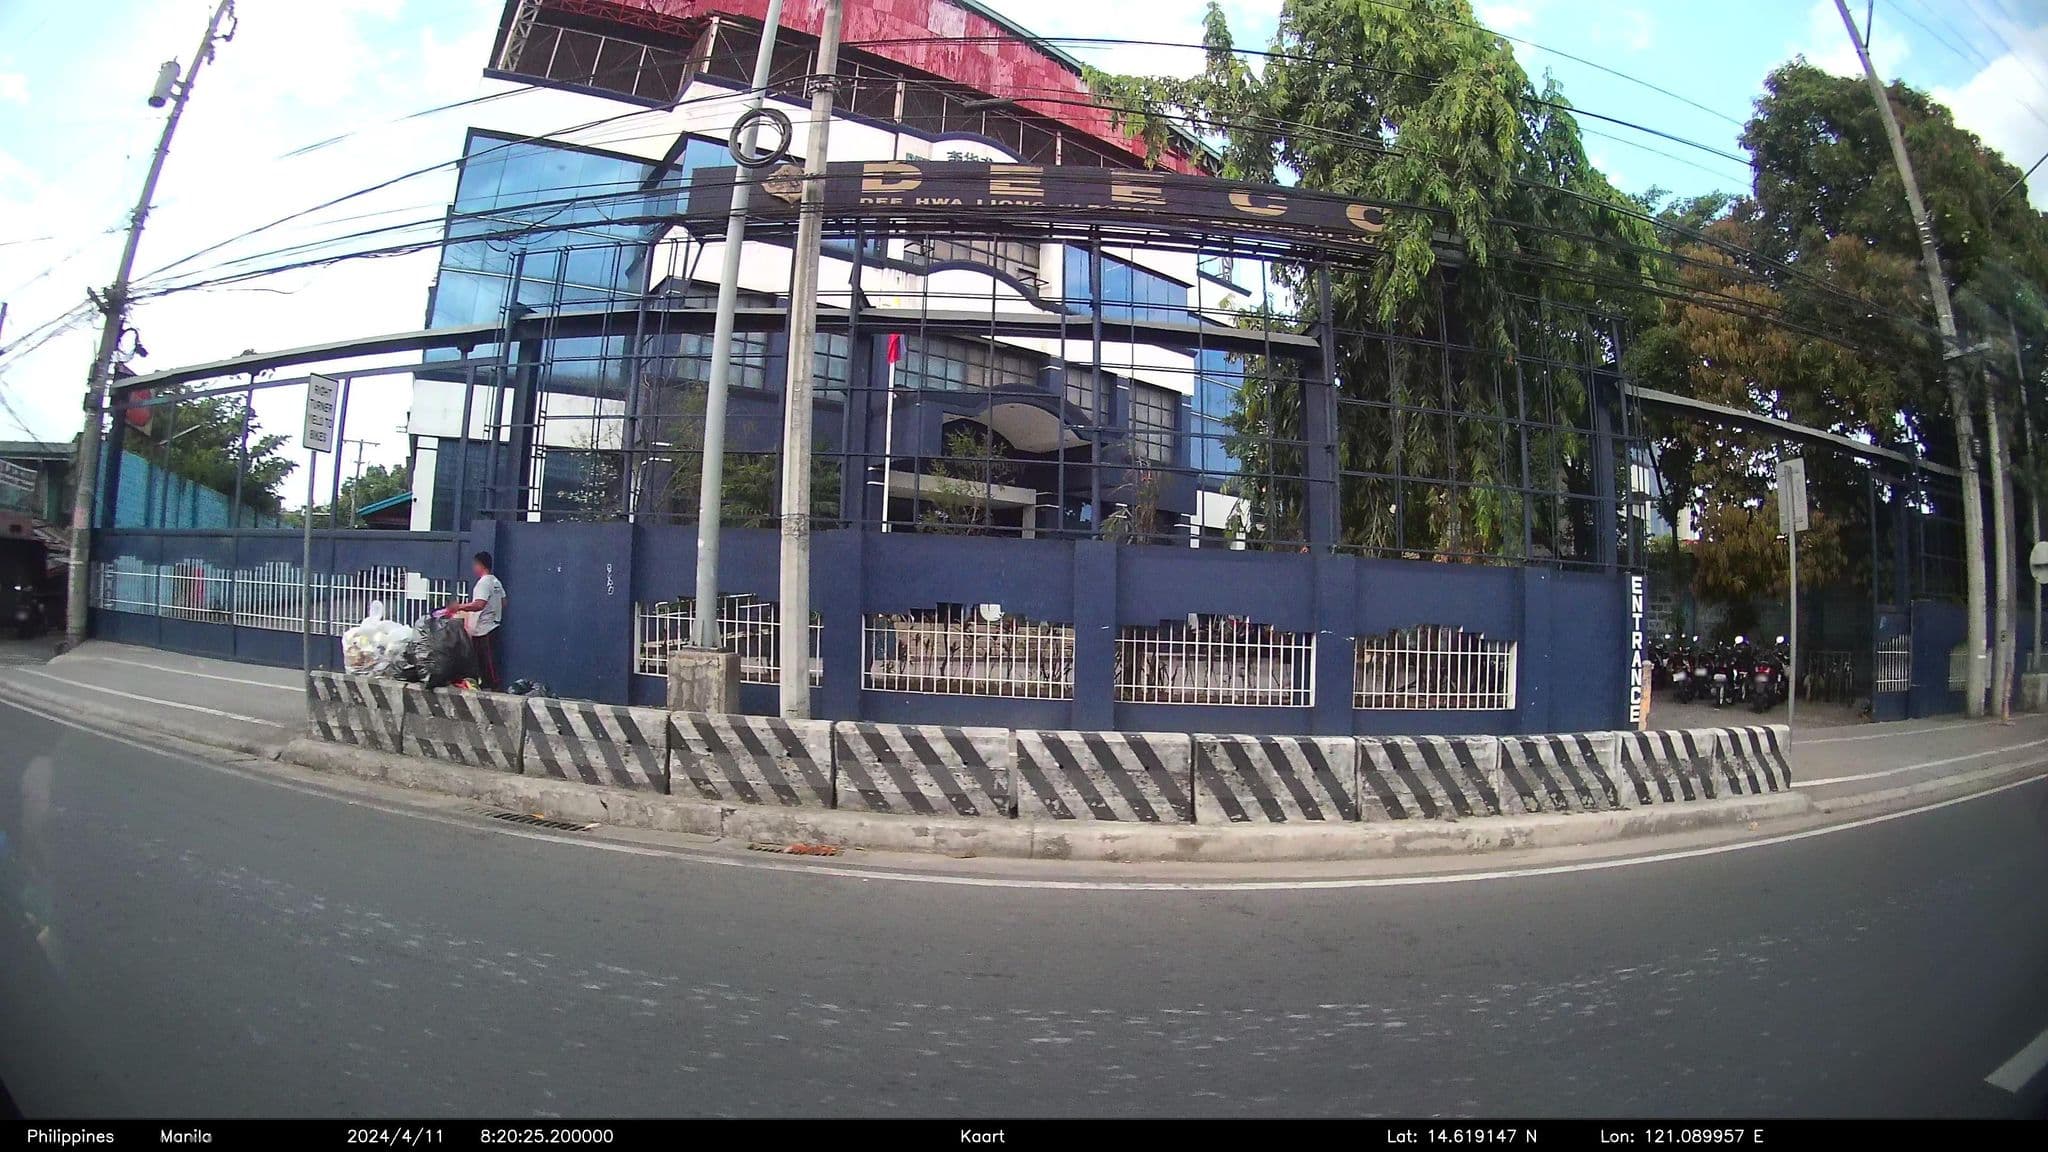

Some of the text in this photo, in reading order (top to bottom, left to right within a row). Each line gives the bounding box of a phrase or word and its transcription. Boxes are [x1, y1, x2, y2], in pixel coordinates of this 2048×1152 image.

[915, 196, 962, 206] HWA
[314, 384, 333, 398] RIGHT
[309, 398, 333, 413] TURNER
[1629, 575, 1643, 723] ENTRANCE
